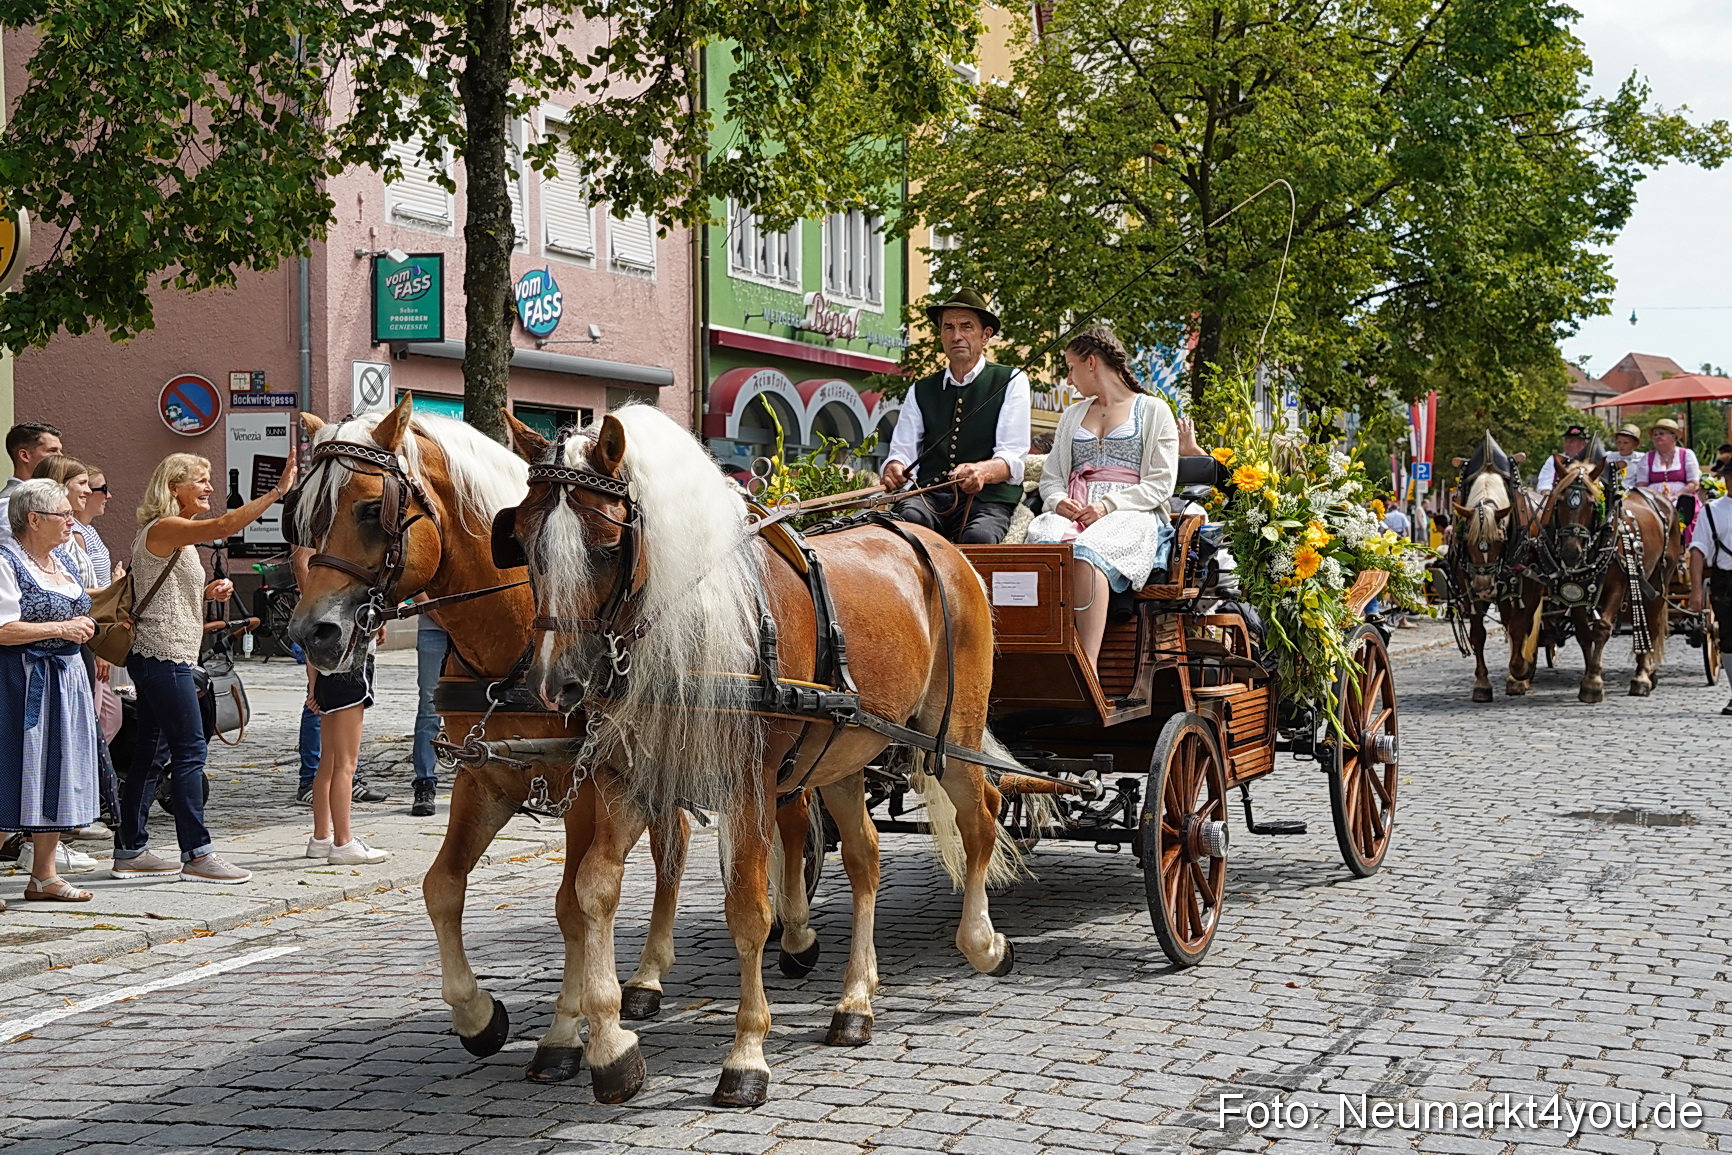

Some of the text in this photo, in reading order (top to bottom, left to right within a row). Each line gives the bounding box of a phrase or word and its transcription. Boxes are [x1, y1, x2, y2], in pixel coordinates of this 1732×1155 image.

[386, 270, 410, 287] vom
[394, 275, 431, 299] FASS
[514, 276, 541, 301] vom
[524, 292, 562, 328] FASS
[763, 308, 801, 328] METZGERE
[232, 394, 294, 407] Bockwirtsgasse
[233, 431, 262, 441] Venezia
